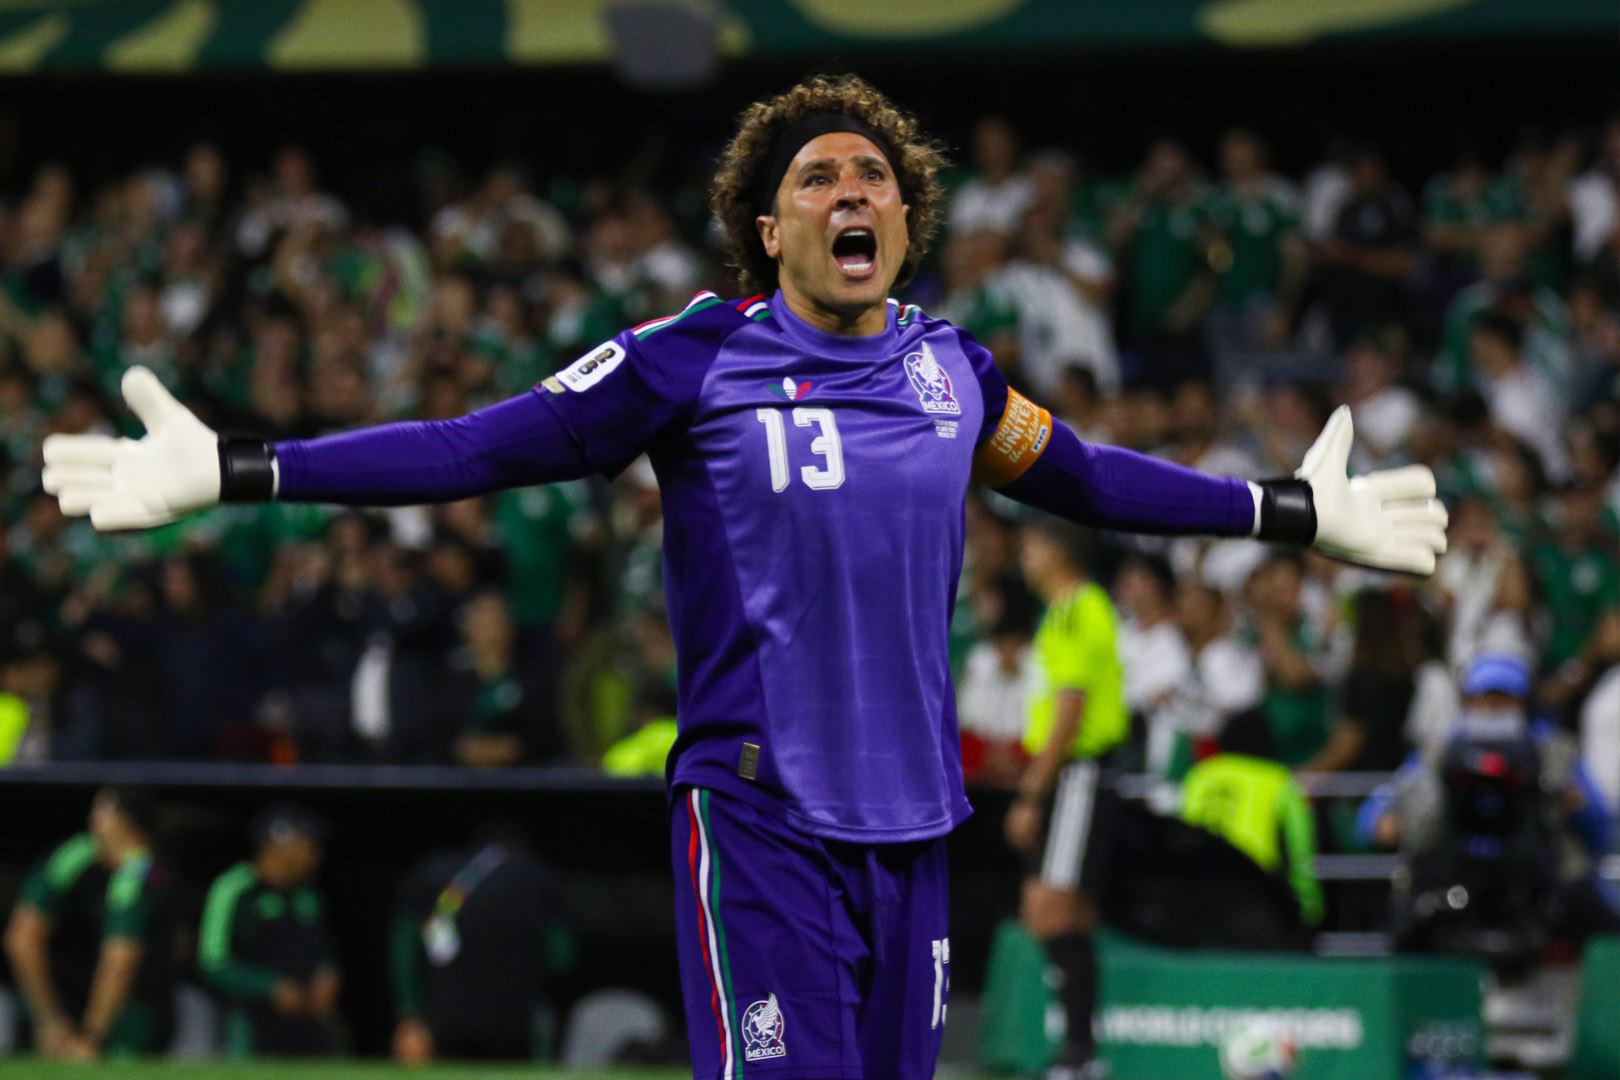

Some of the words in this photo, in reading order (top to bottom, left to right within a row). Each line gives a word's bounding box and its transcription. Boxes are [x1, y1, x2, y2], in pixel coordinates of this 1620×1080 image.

[990, 391, 1021, 448] FOOTBALL
[997, 400, 1031, 455] UNITES
[756, 407, 846, 493] 13
[747, 1046, 783, 1058] MÉXICO
